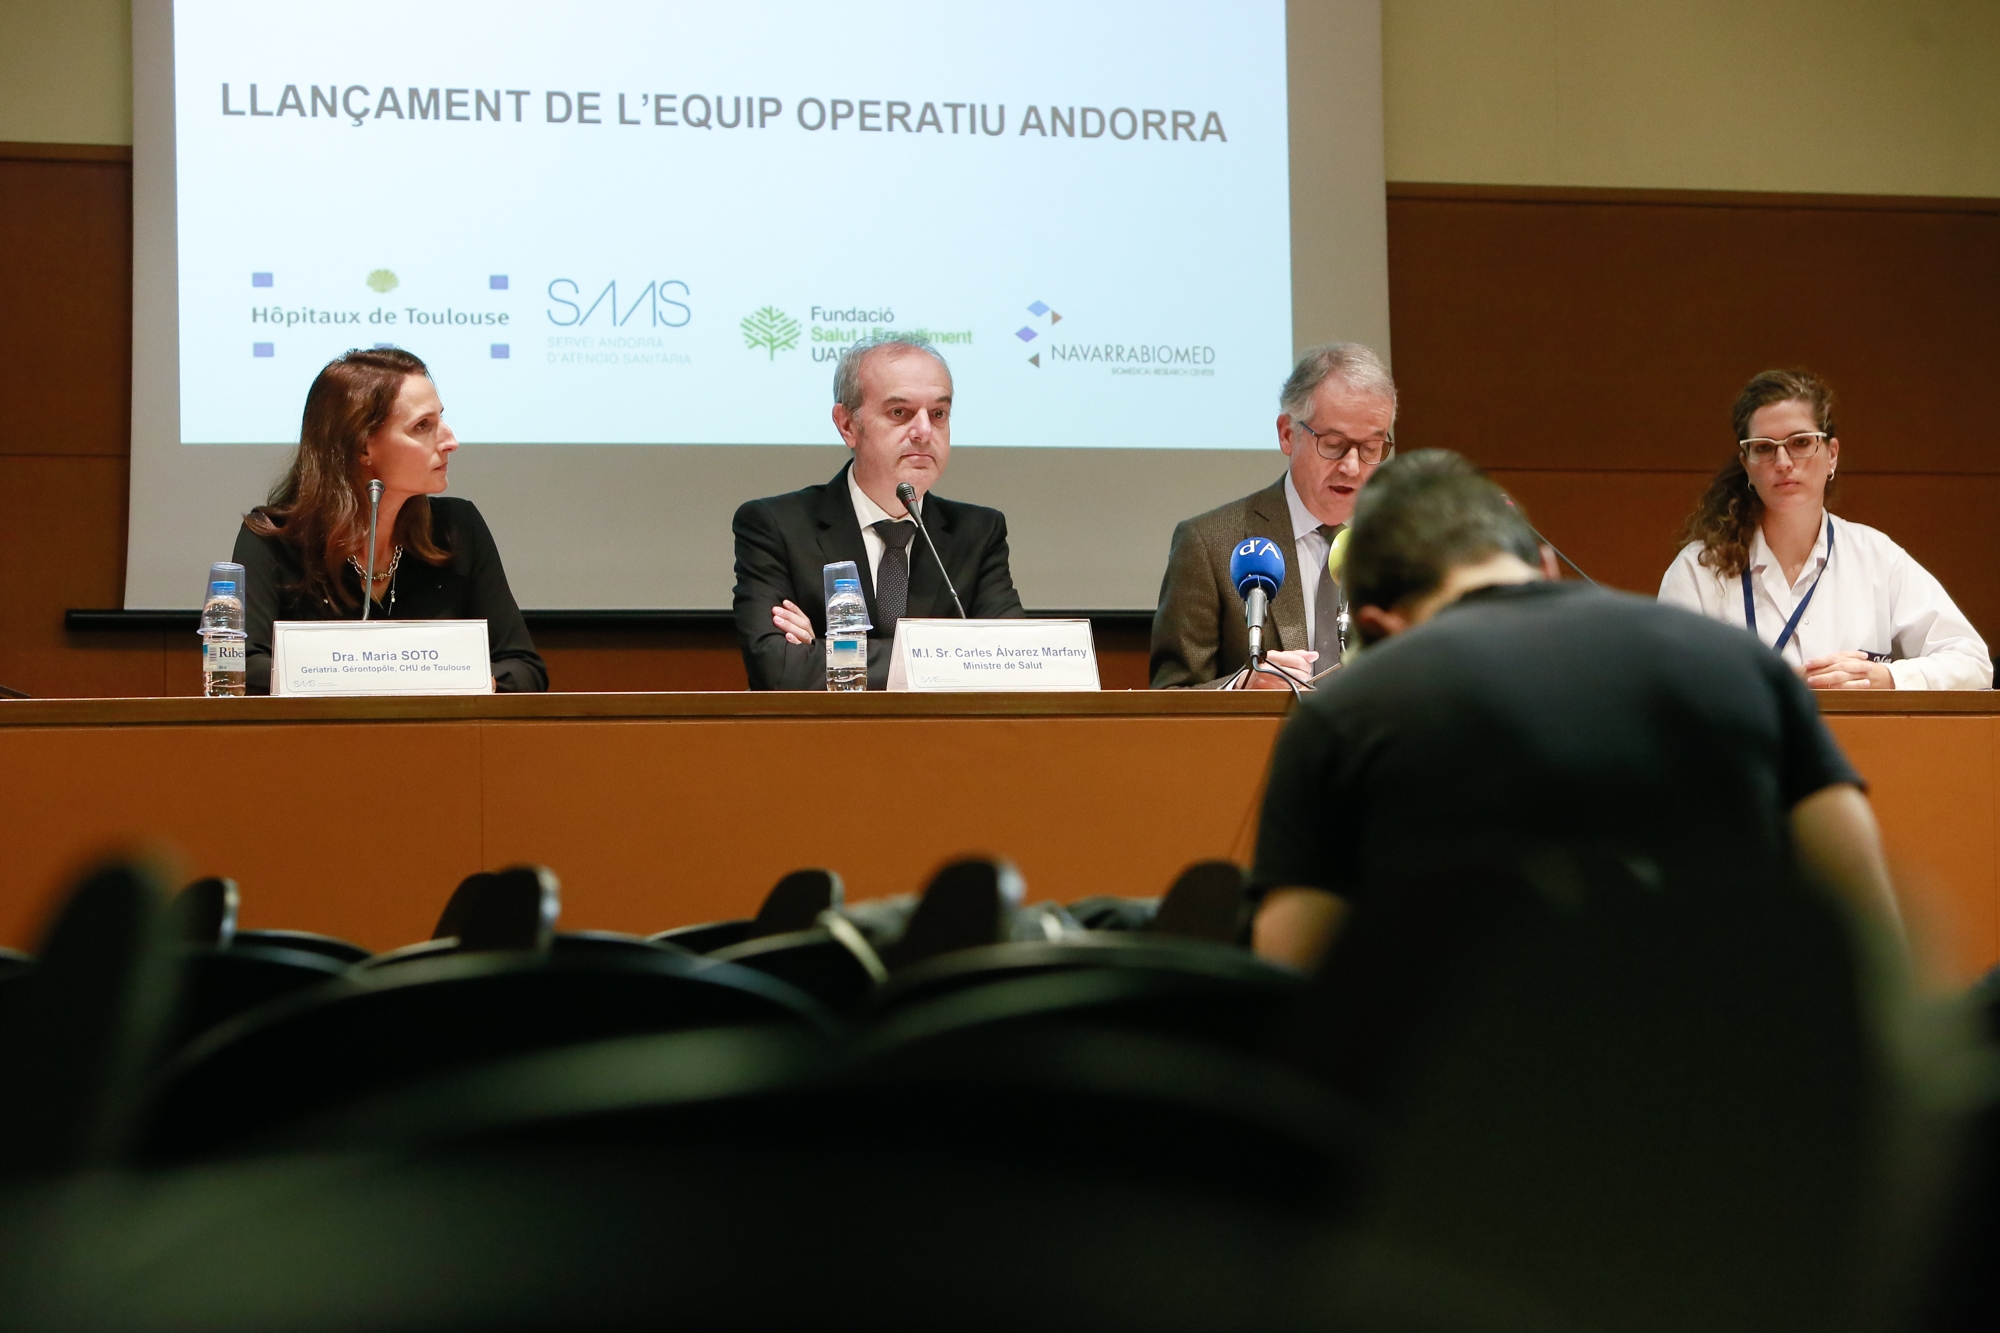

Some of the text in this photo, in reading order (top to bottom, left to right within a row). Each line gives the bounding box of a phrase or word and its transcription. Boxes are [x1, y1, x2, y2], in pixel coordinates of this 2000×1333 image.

[222, 82, 1228, 142] LLANÇAMENT DE L’EQUIP OPERATIU ANDORRA
[251, 306, 510, 328] Hôpitaux de Toulouse
[811, 306, 895, 323] Fundació
[811, 327, 857, 342] Salut
[547, 336, 594, 349] SERVEI
[623, 351, 692, 366] SANITÀRIA
[1051, 343, 1216, 365] NAVARRABIOMED
[332, 650, 439, 662] Dra. Maria SOTO
[912, 644, 1087, 660] M.I. Sr. Carles Álvarez Marfany
[301, 663, 471, 674] Geriatria. Gérontopôle, CHU de Toulouse
[963, 660, 1043, 670] Ministre de Salut
